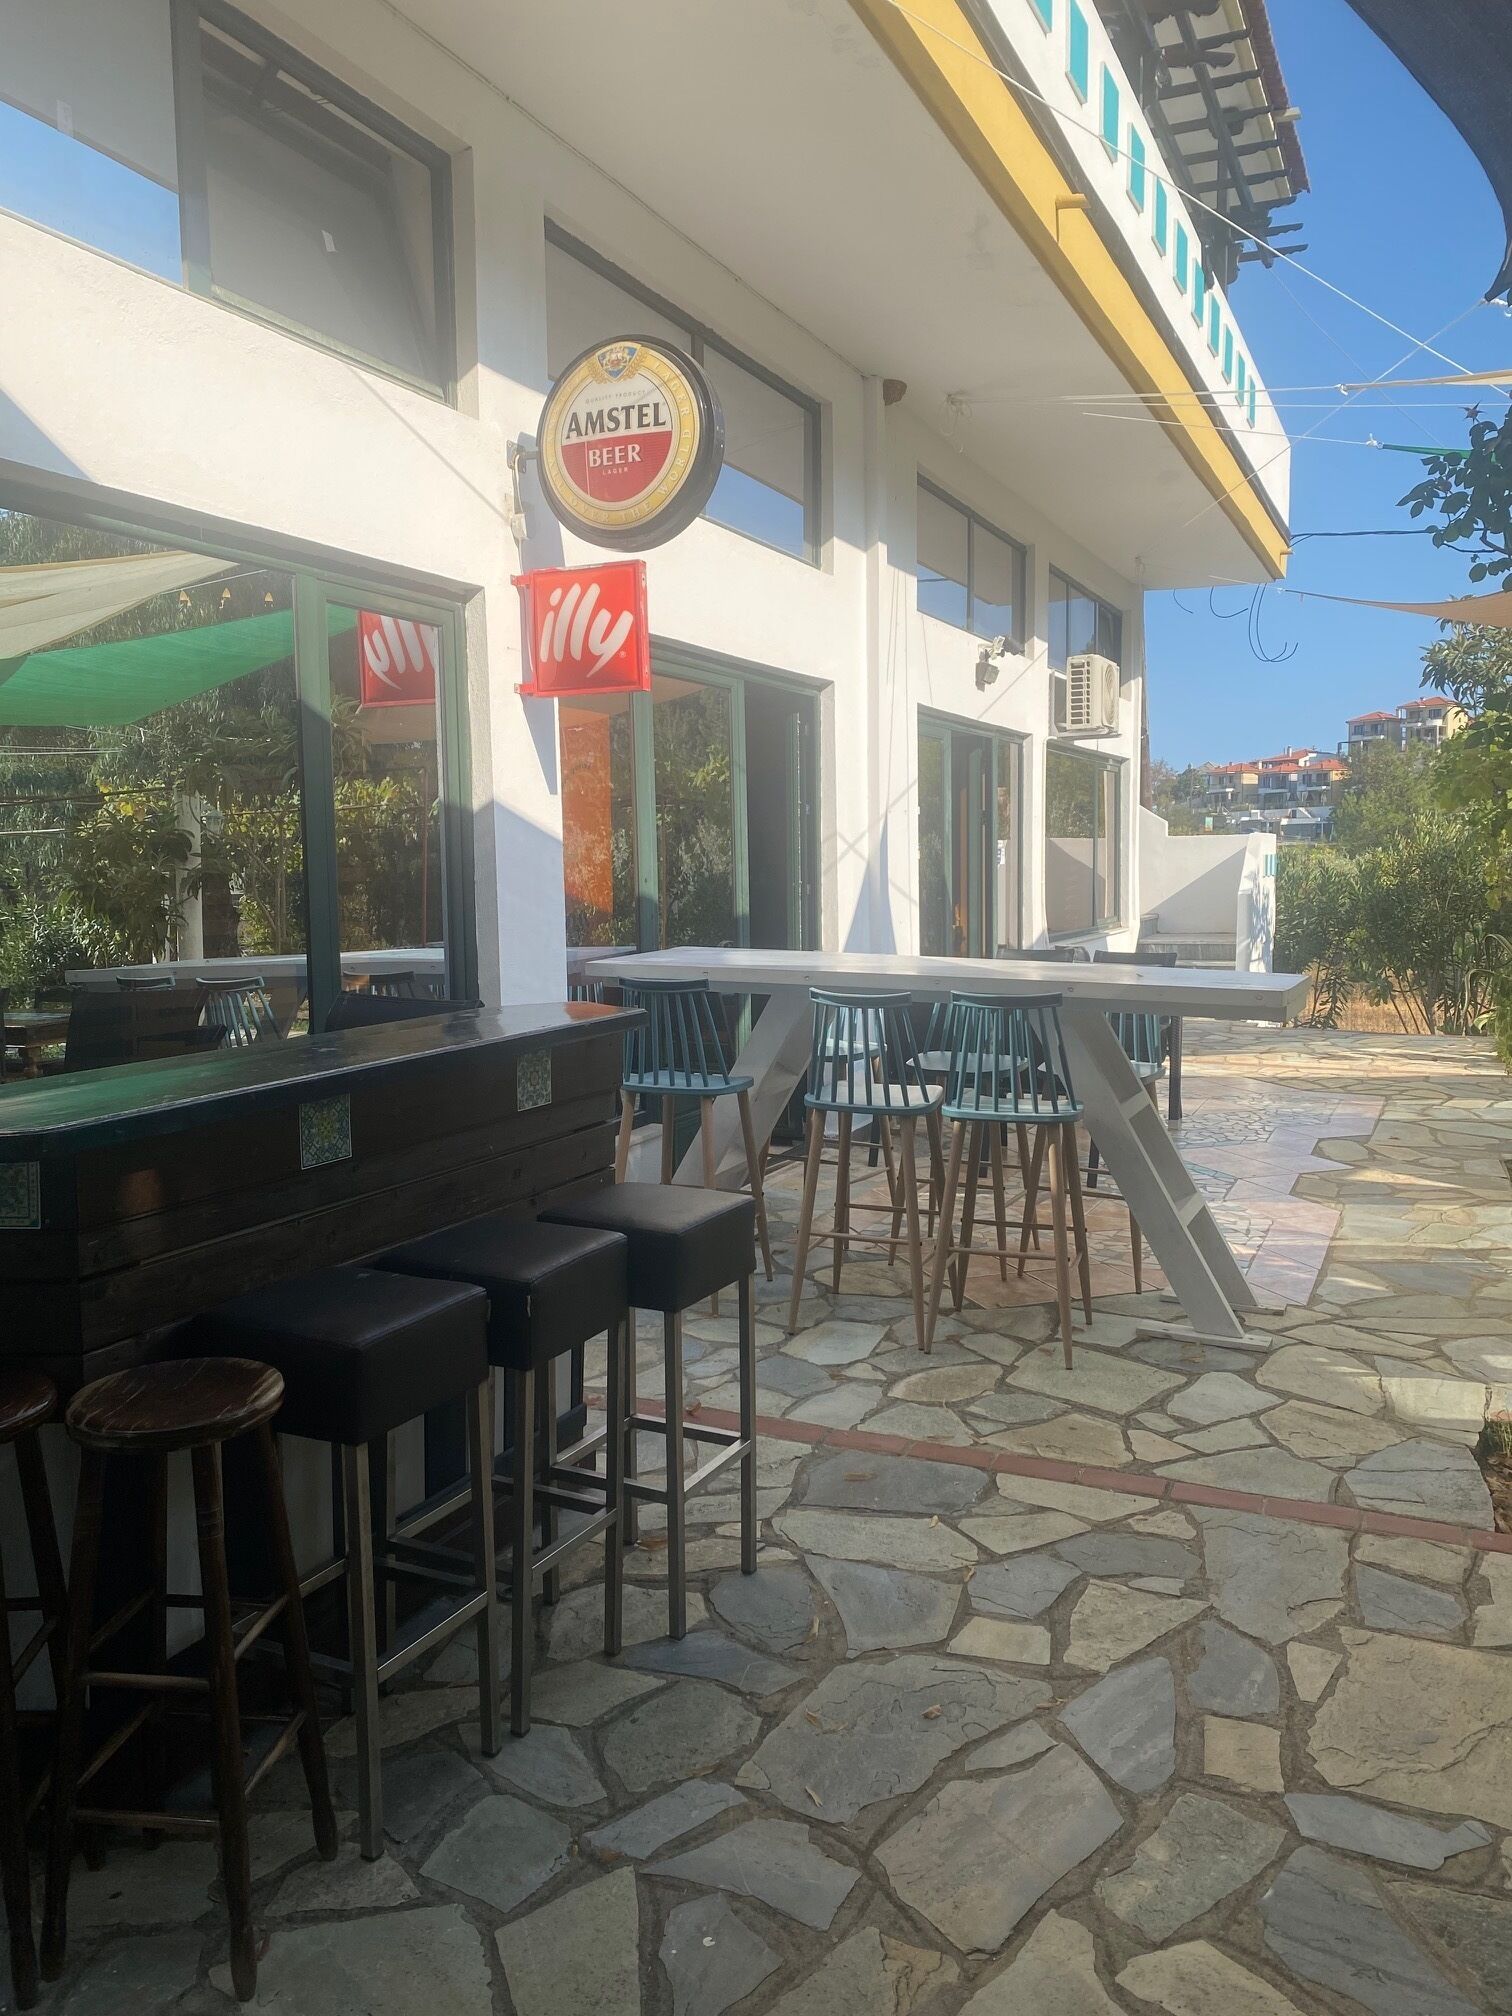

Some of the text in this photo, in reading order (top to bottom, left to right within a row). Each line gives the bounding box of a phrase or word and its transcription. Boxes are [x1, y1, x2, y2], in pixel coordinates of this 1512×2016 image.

[585, 389, 646, 404] QUALITY PRODUCT
[565, 402, 666, 439] AMSTEL
[588, 444, 641, 467] BEER
[602, 467, 628, 475] LAGER
[619, 500, 652, 521] THE
[660, 431, 692, 495] WORLD
[540, 582, 634, 678] illy
